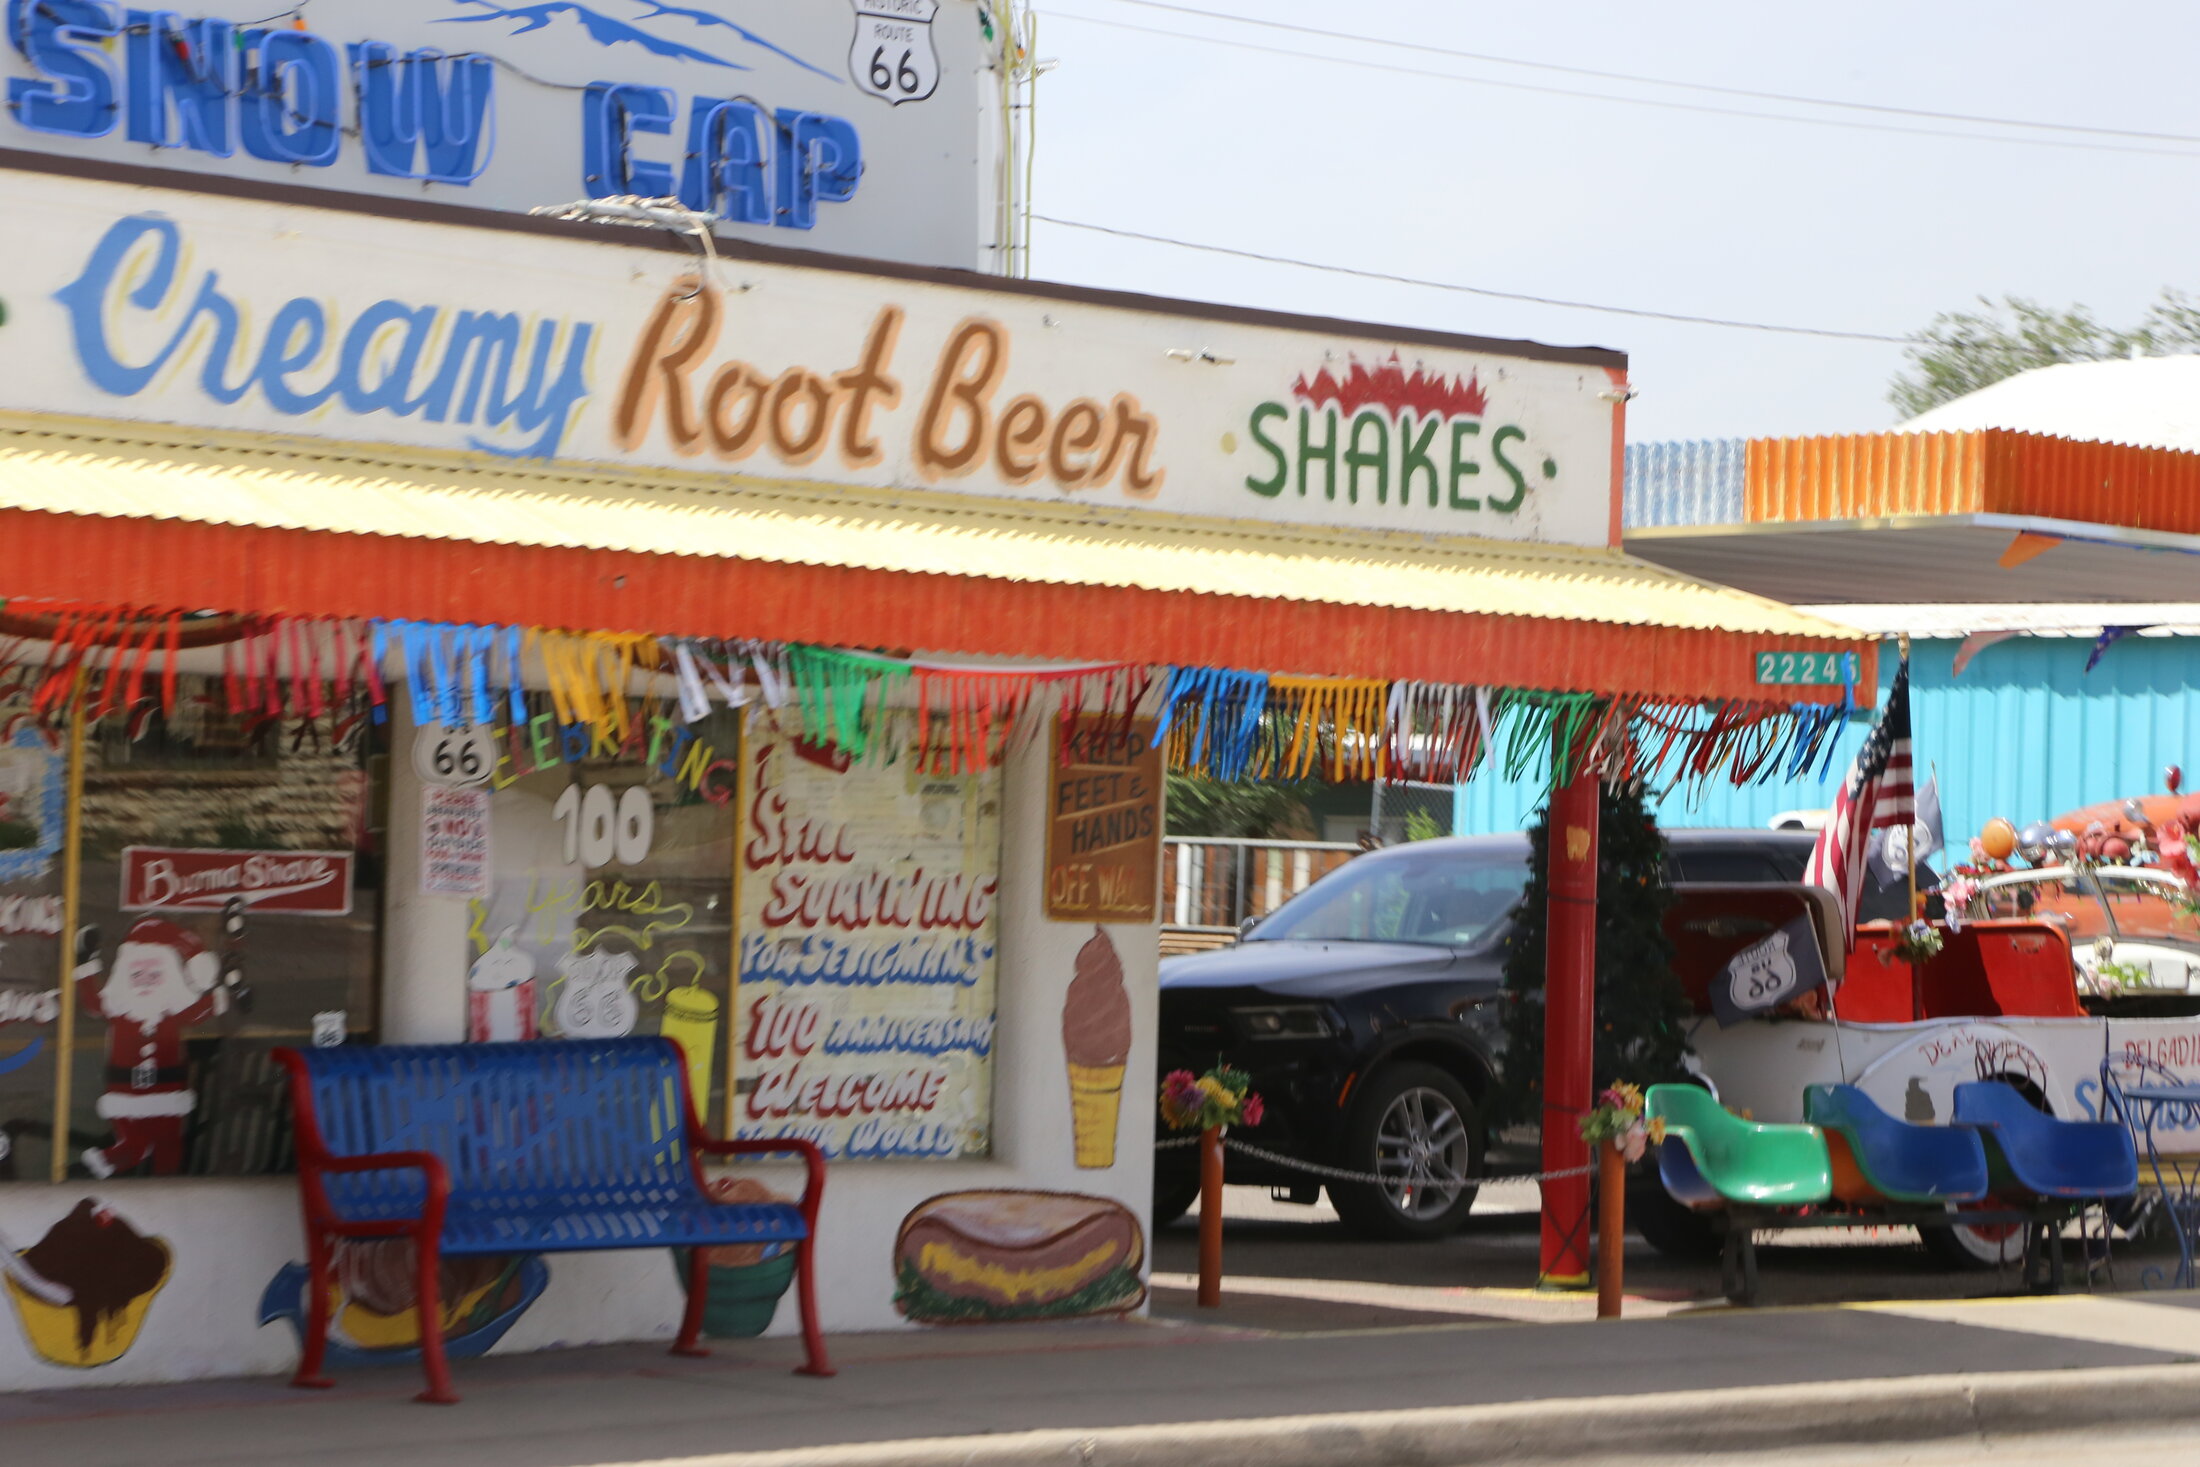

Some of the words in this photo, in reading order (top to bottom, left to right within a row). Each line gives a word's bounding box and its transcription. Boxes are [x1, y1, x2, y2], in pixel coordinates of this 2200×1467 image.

[874, 23, 914, 42] ROUTE
[870, 43, 918, 93] 66
[6, 0, 496, 187] SNOW
[582, 80, 864, 230] CAP
[52, 212, 597, 459] Creamy
[612, 275, 905, 471] Root
[914, 315, 1166, 500] Beer
[1245, 401, 1527, 514] SHAKES
[433, 738, 480, 776] 66
[1056, 772, 1124, 815] FEET
[551, 782, 655, 868] 100
[1071, 804, 1154, 855] HANDS
[746, 996, 819, 1059] 100
